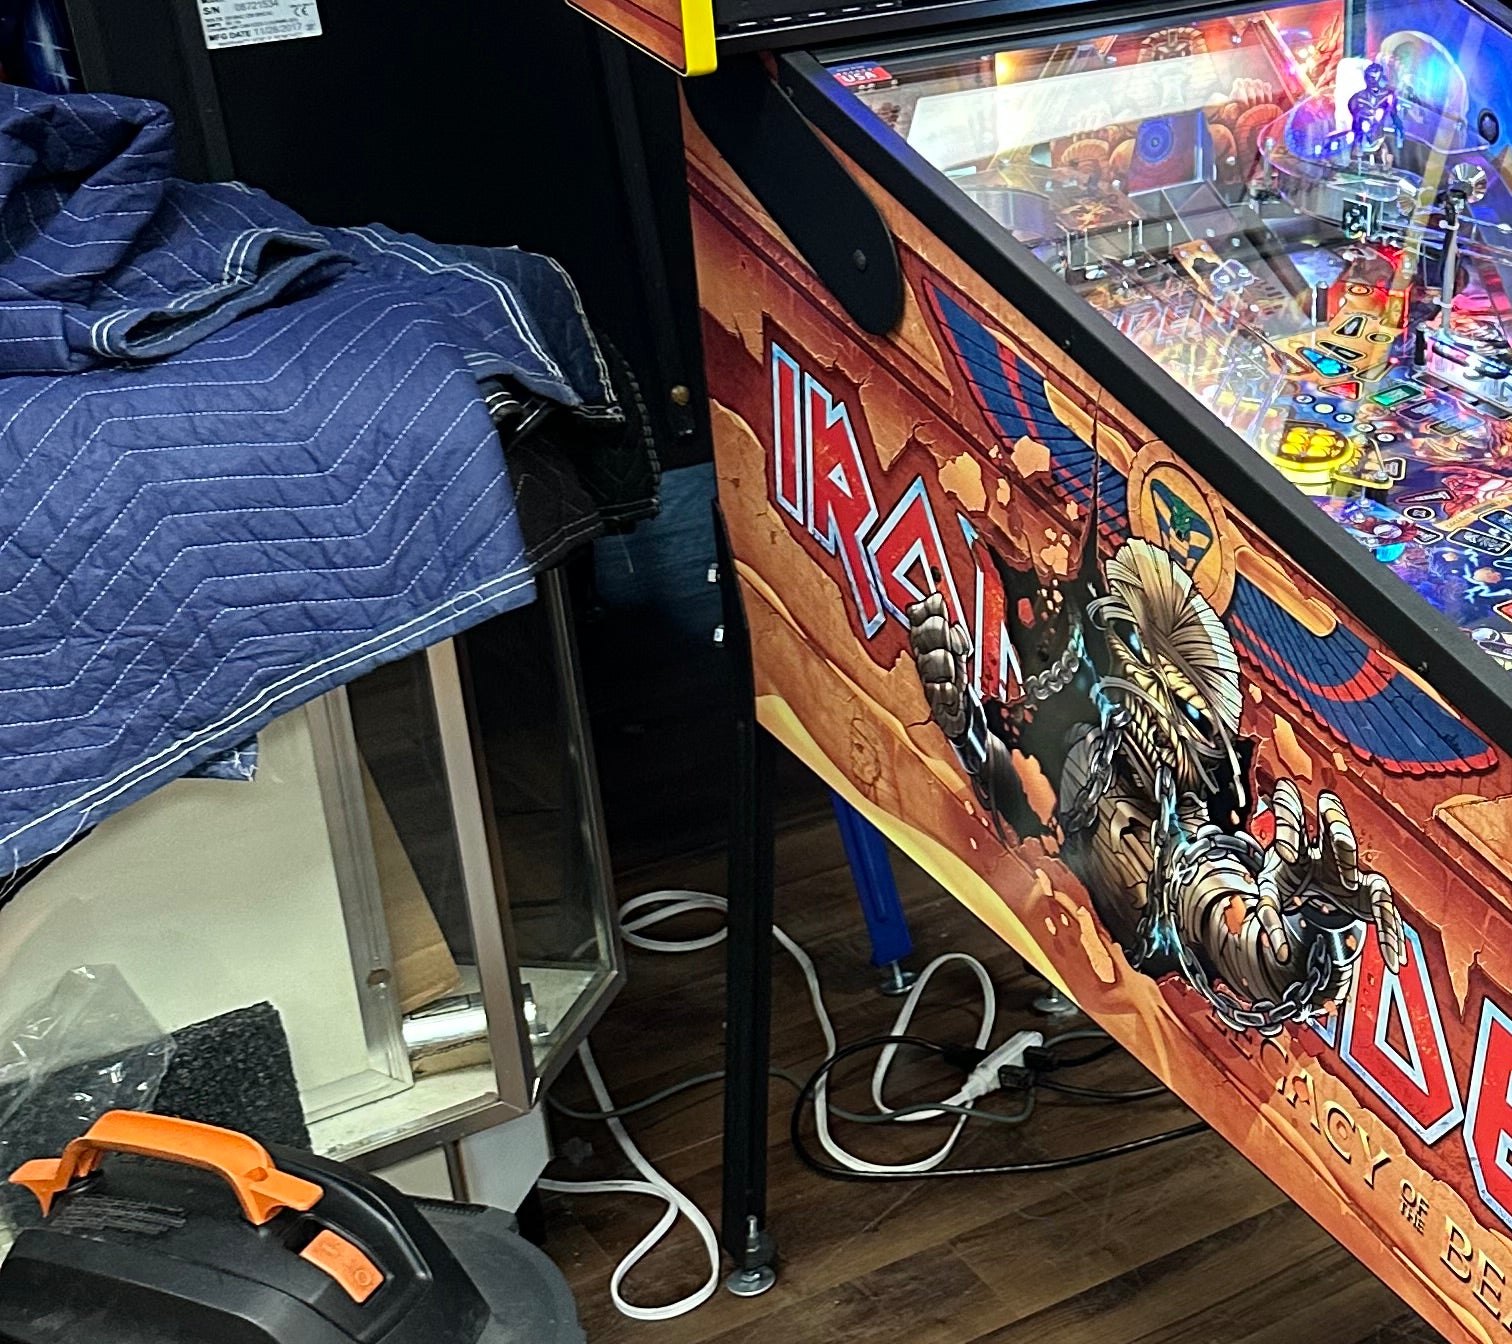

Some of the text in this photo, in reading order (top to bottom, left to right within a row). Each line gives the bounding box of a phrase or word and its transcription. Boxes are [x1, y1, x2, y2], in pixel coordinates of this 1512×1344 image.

[203, 6, 221, 15] S/N
[229, 30, 251, 39] DATE
[1399, 1178, 1430, 1216] OF
